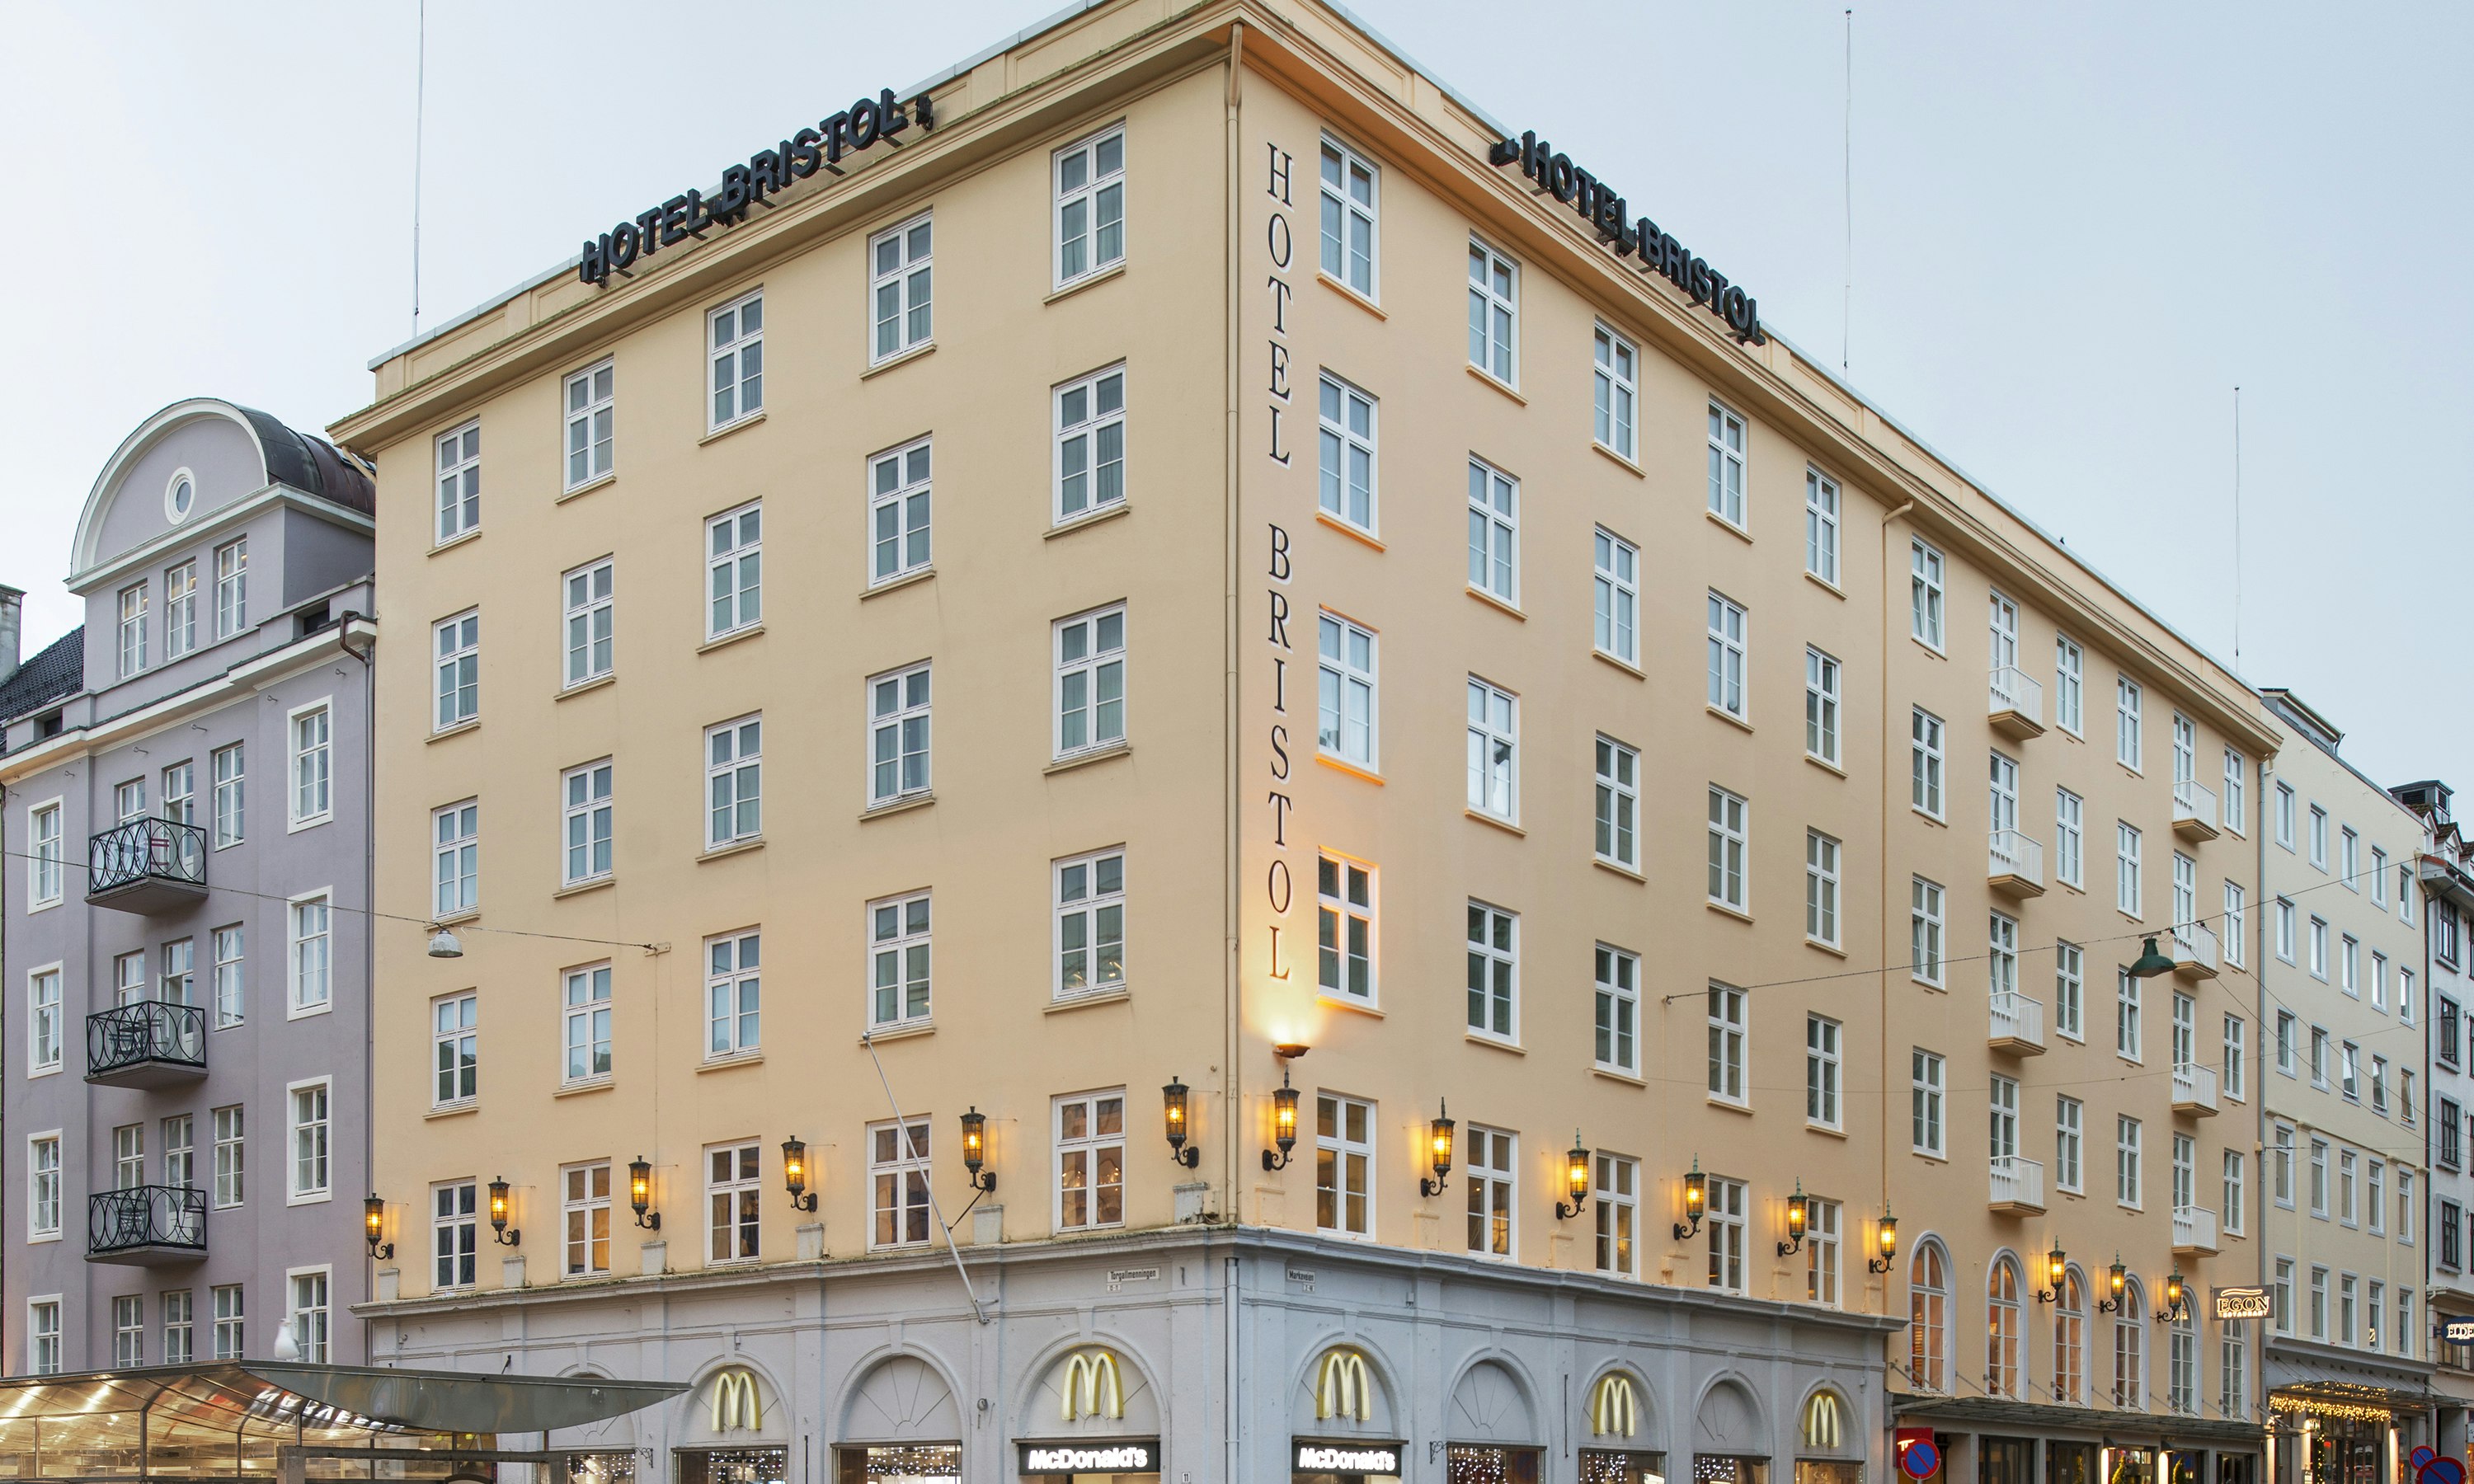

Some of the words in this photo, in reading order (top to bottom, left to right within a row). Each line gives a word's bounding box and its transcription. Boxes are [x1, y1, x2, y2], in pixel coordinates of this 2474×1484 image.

[580, 188, 713, 284] HOTEL
[722, 87, 909, 214] BRISTOL
[1522, 129, 1637, 252] HOTEL
[1638, 217, 1766, 347] BRISTOL
[1267, 142, 1294, 467] HOTEL
[1268, 523, 1292, 981] BRISTOL
[1110, 1270, 1156, 1281] Torgallmenningen
[2217, 1296, 2269, 1313] EGON
[2446, 1327, 2474, 1338] ELDE
[1028, 1447, 1148, 1469] McDonald's
[1299, 1448, 1395, 1471] McDonald's
[1183, 1473, 1189, 1482] 11
